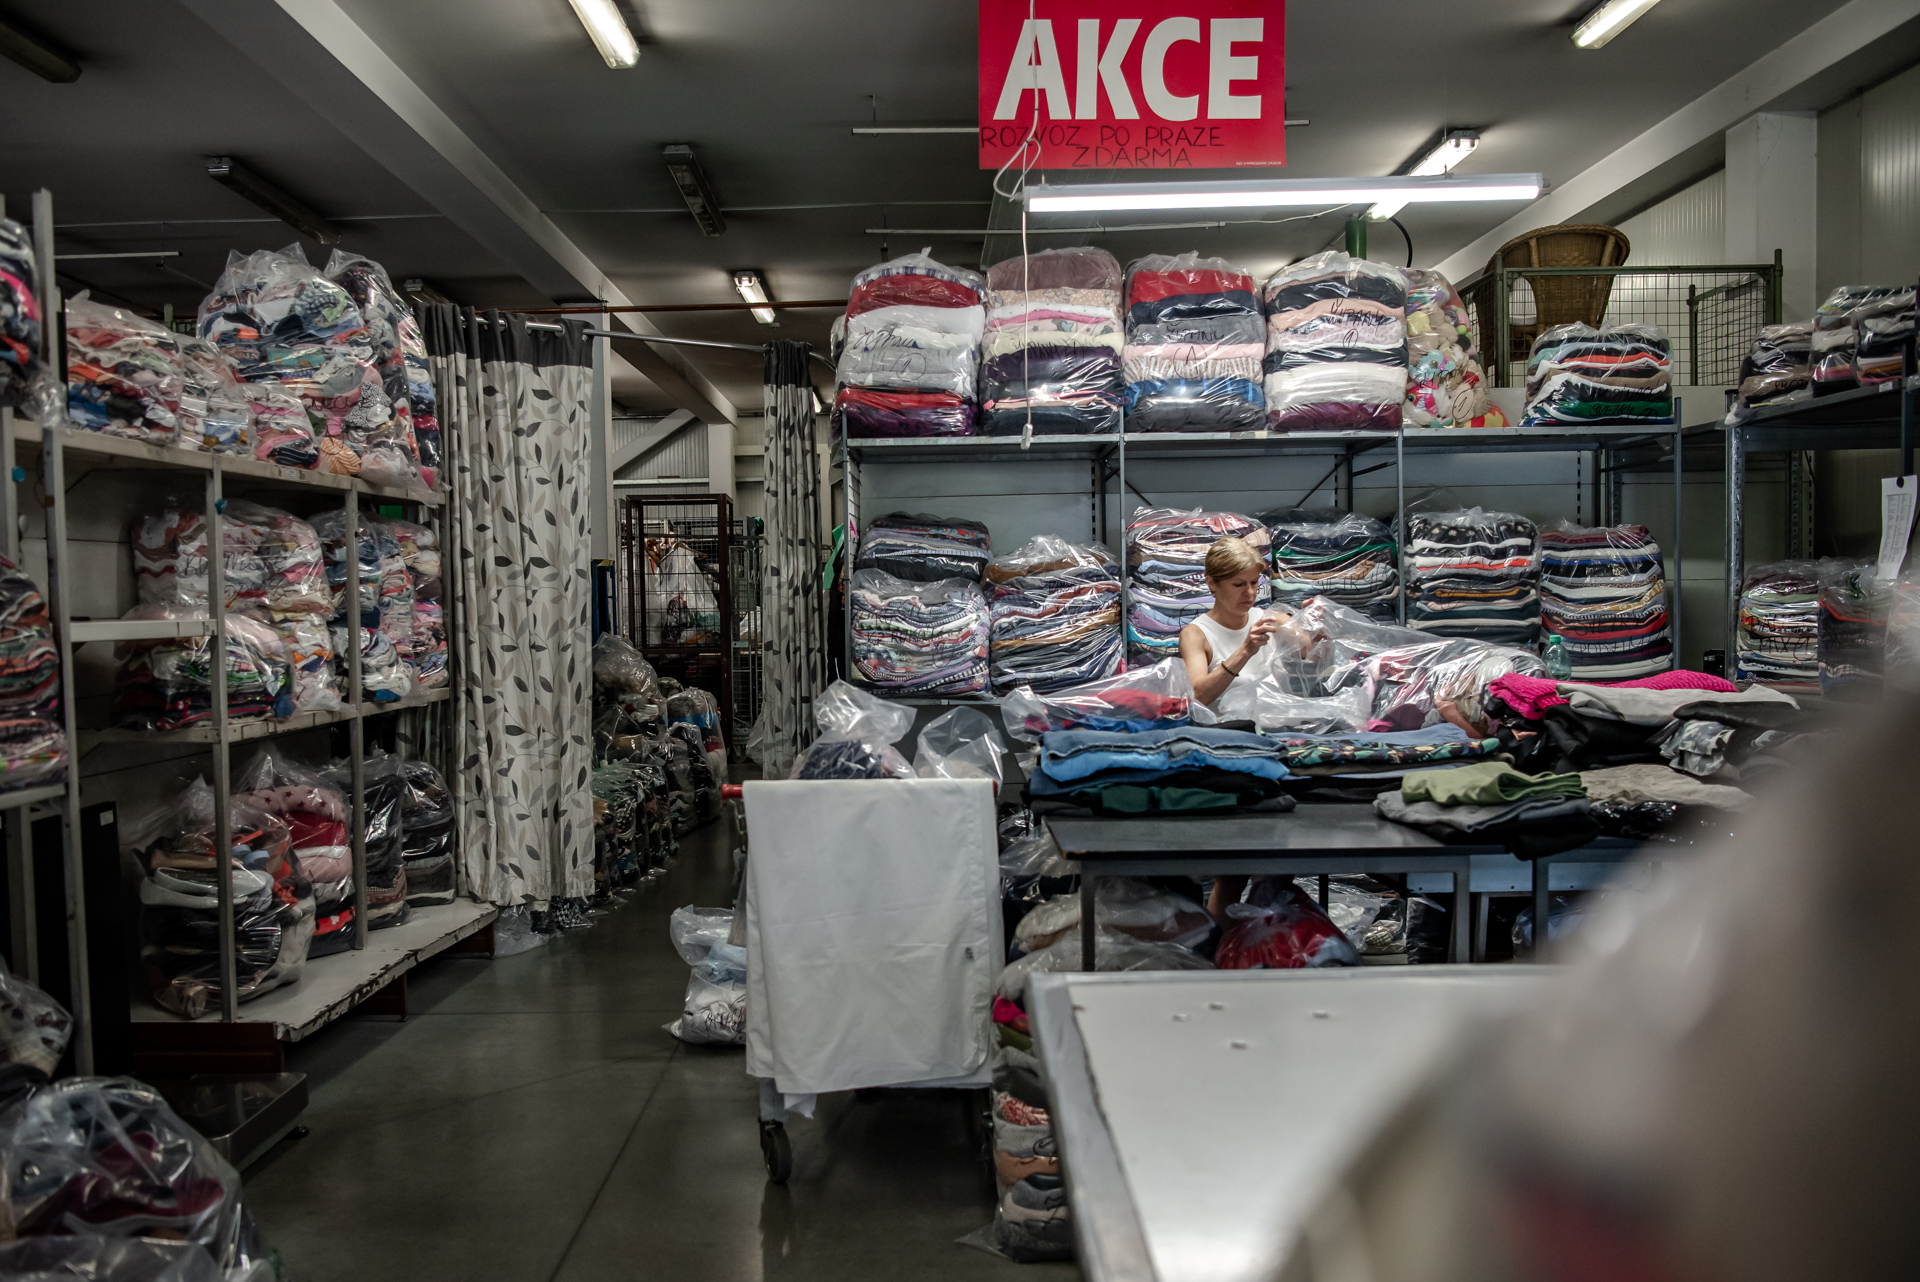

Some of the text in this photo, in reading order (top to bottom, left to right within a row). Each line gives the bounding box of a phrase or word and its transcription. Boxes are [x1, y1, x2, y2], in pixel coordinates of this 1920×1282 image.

[993, 16, 1264, 121] AKCE
[981, 125, 1224, 148] ROZVOZ PO PRAZE
[1072, 146, 1192, 168] ZDARMA
